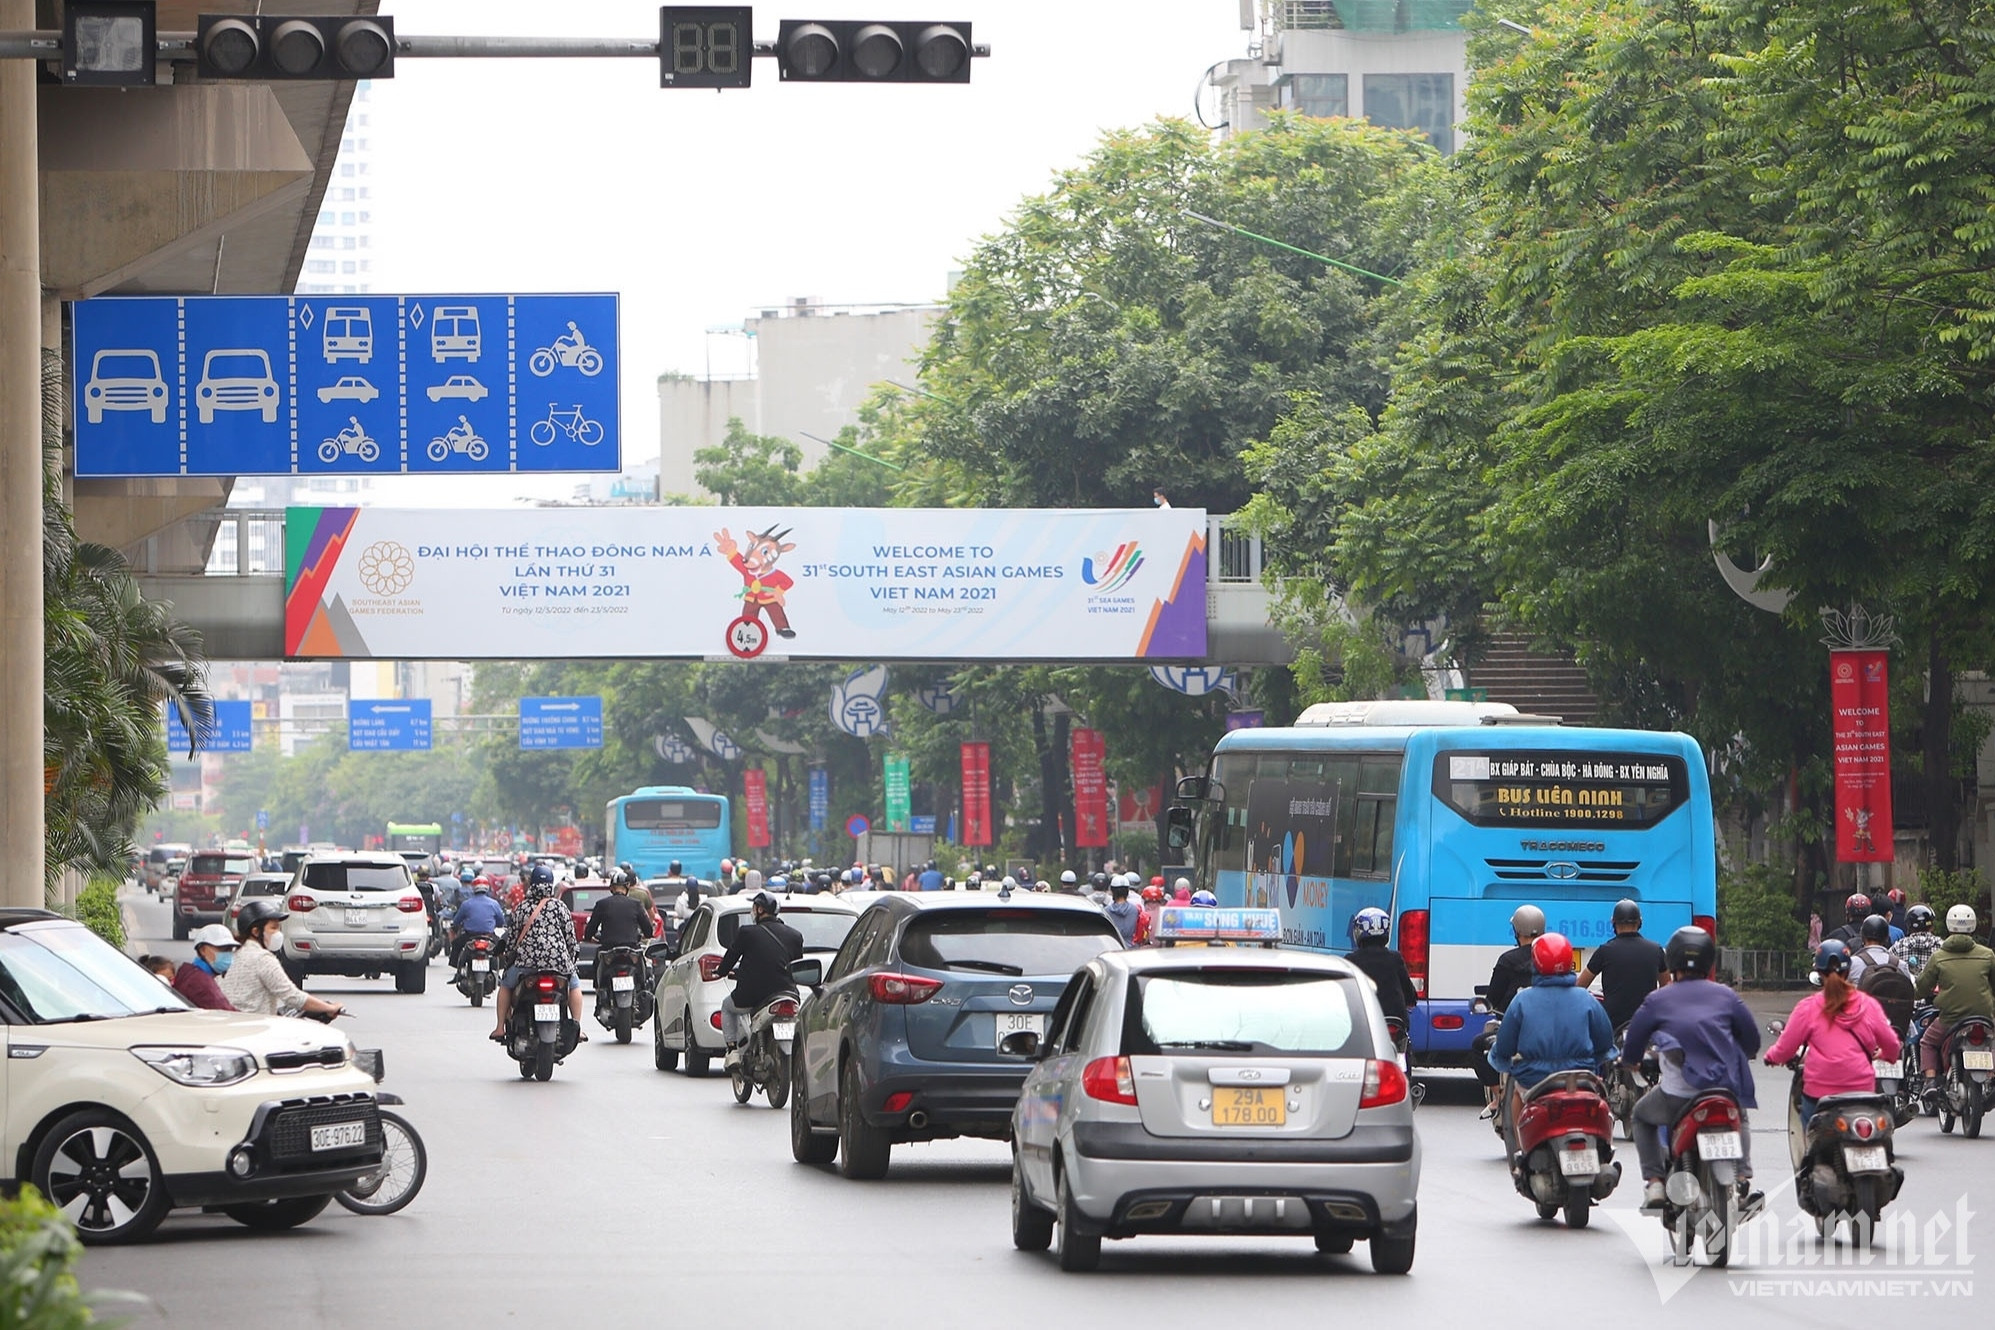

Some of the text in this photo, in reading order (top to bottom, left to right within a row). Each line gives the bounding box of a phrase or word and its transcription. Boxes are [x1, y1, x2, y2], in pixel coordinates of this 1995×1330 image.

[417, 542, 712, 560] ĐẠI HỘI THỂ THAO ĐÔNG NAM Á
[873, 546, 993, 558] WELCOME TO
[556, 563, 594, 577] THỨ
[599, 565, 615, 577] 31
[828, 565, 888, 577] SOUTH
[894, 566, 938, 578] EAST
[942, 566, 996, 578] ASIAN
[1002, 566, 1064, 578] GAMES
[499, 583, 630, 600] VIỆT NAM 2021
[870, 587, 996, 599] VIET NAM 2021
[1838, 708, 1880, 716] WELCOME
[1859, 743, 1885, 751] GAMES
[1490, 762, 1500, 776] BX
[1501, 759, 1519, 777] GIÁP
[1520, 760, 1534, 777] BÁT
[1561, 761, 1576, 780] BỘC
[1593, 761, 1614, 779] ĐÔNG
[1620, 765, 1630, 779] BX
[1498, 784, 1622, 806] BUS LIÊN NINH
[1510, 807, 1624, 819] Hotline 1900.1298
[1303, 881, 1328, 908] MONEY
[1008, 1015, 1032, 1029] 30E
[1233, 1089, 1264, 1105] 29A
[1222, 1107, 1278, 1122] 178.00
